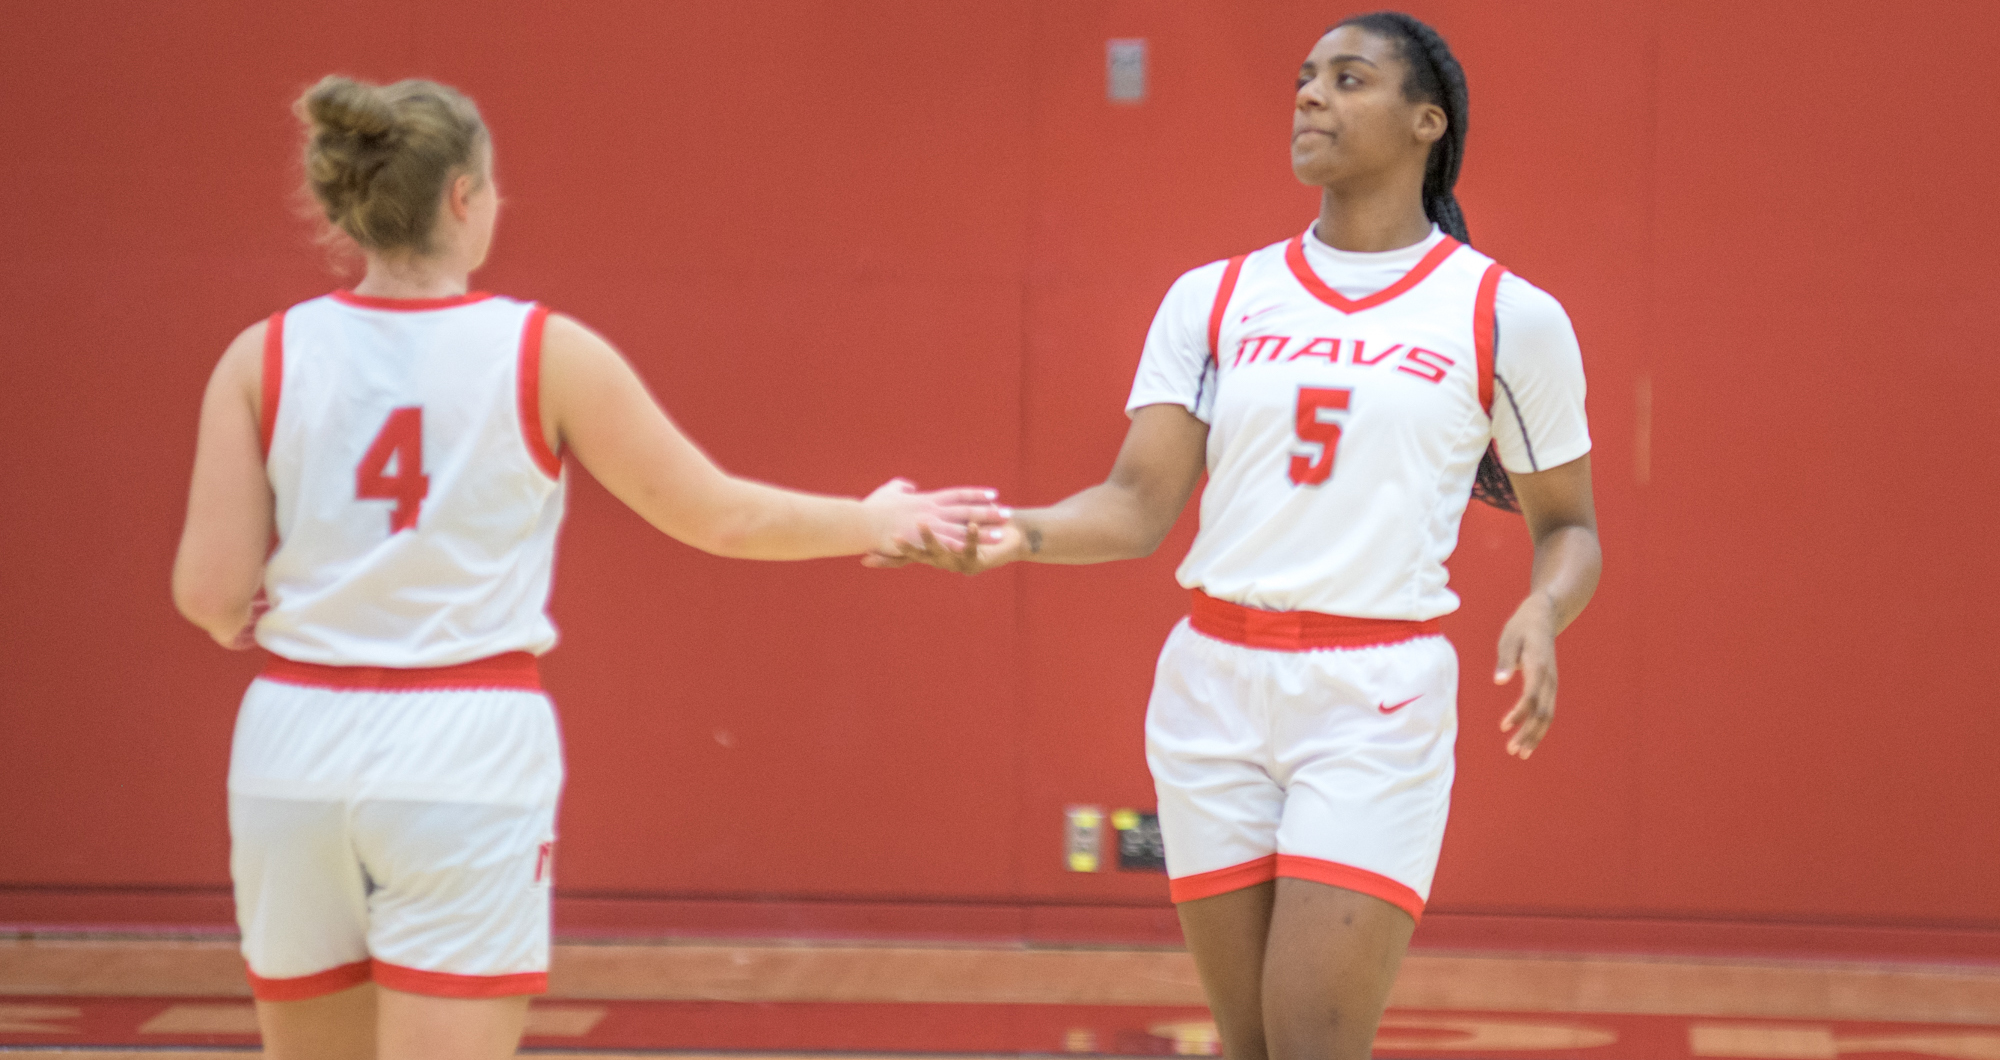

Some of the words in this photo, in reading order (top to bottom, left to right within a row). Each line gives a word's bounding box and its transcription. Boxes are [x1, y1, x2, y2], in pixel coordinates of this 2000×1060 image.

[1232, 334, 1456, 384] MAVS
[354, 405, 431, 535] 4
[1287, 385, 1353, 488] 5
